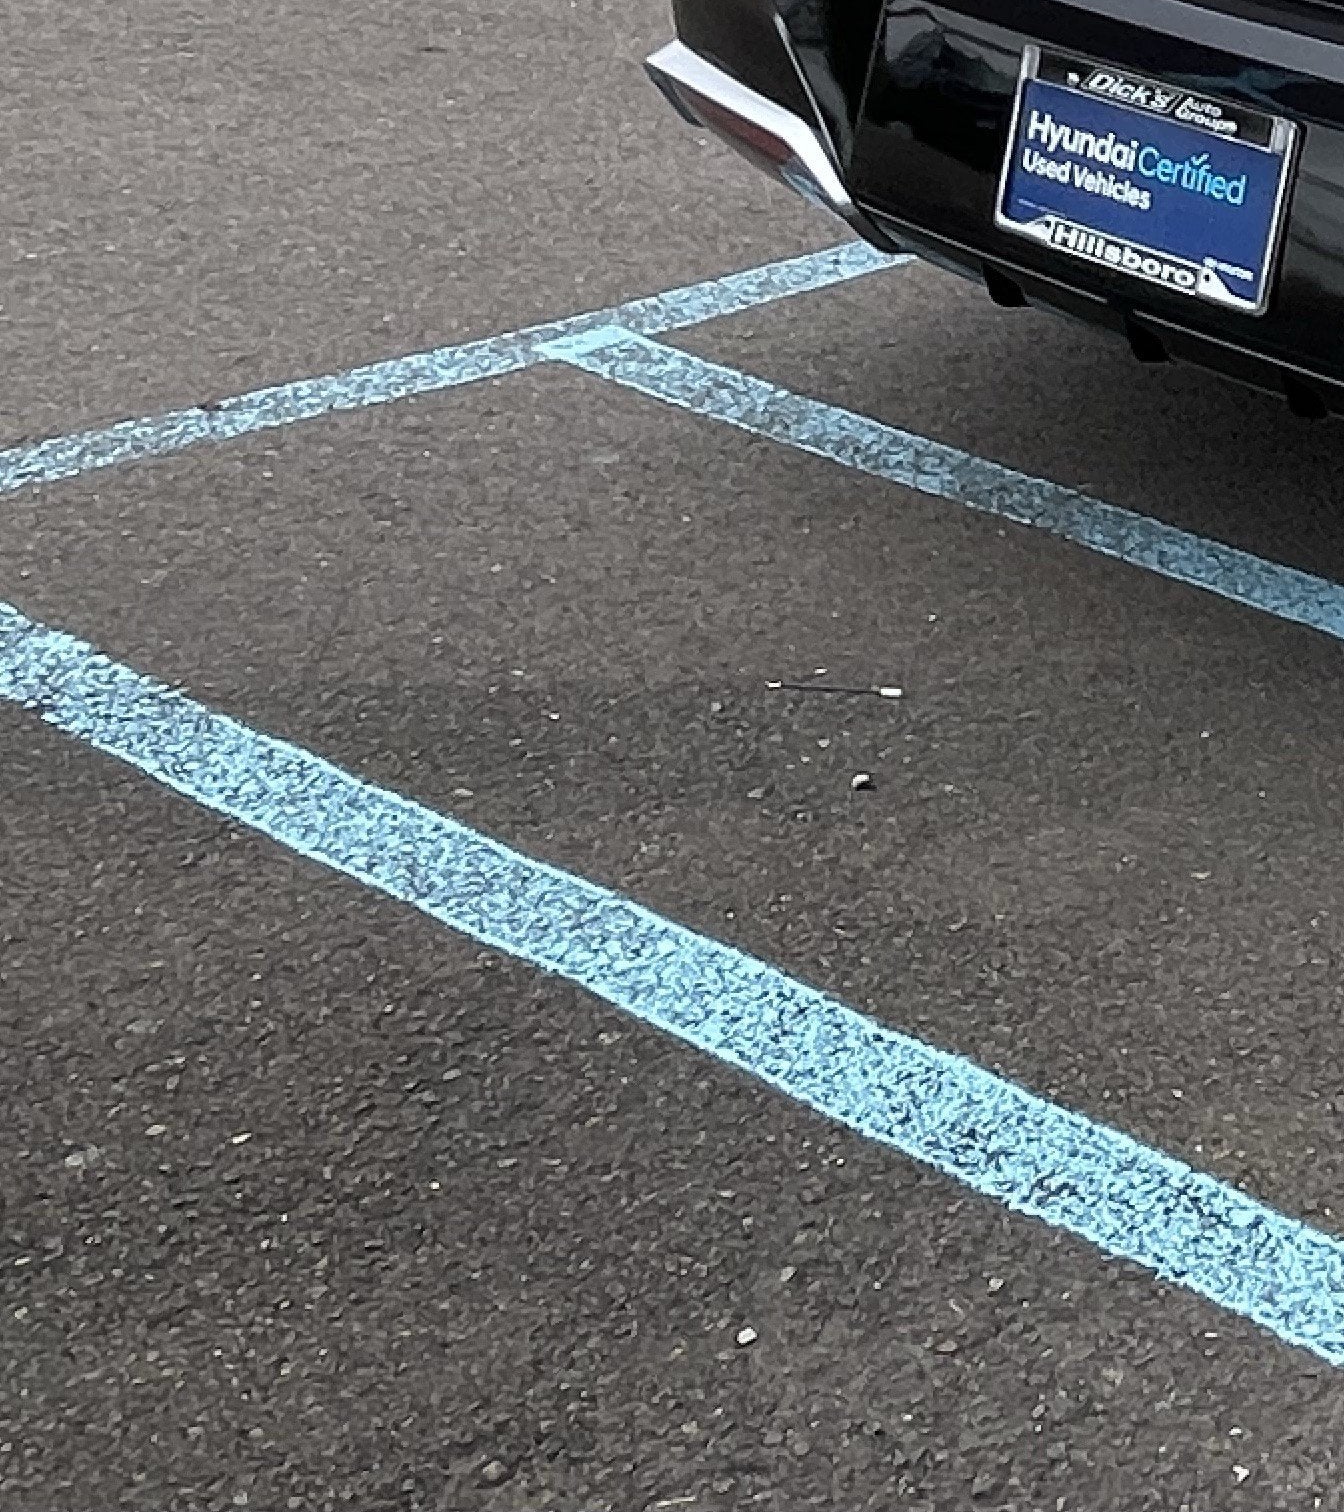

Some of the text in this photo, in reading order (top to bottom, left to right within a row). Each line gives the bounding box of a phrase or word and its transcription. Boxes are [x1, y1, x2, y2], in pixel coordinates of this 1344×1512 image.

[1088, 72, 1173, 109] Dick's
[1022, 148, 1152, 210] Used Vehicles
[1028, 110, 1248, 206] Hyundai Certified
[1055, 224, 1196, 286] Hillsboro
